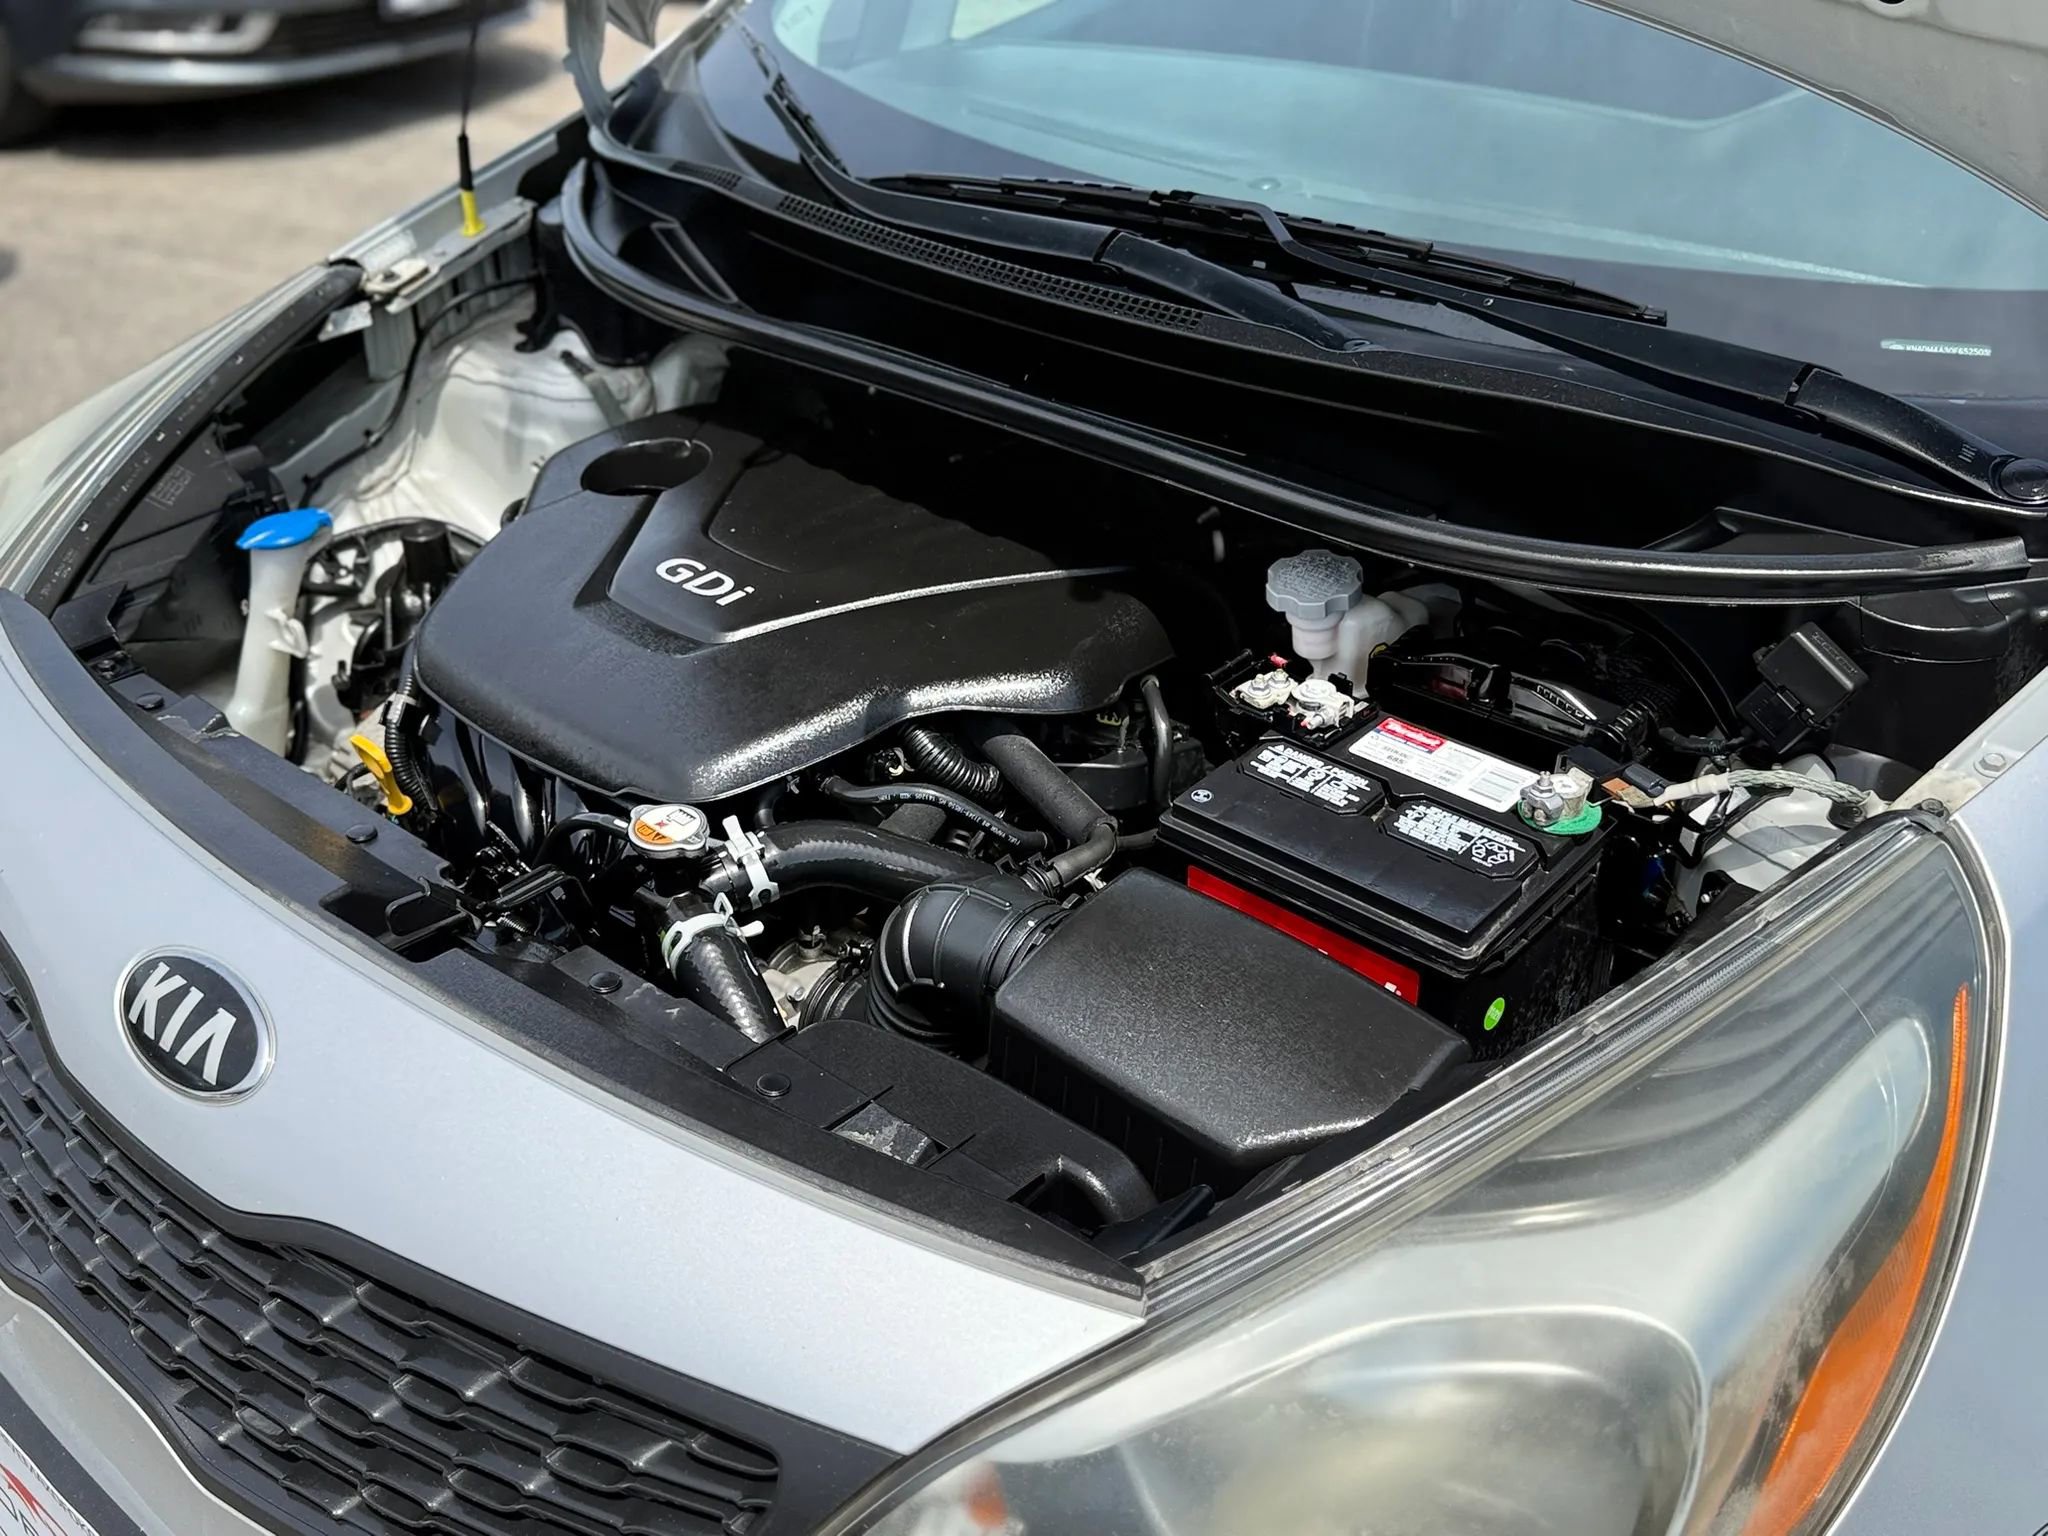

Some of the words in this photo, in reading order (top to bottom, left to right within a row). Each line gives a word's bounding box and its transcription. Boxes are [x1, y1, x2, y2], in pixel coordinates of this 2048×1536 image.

[655, 557, 756, 607] GDi
[1283, 747, 1325, 768] DANGER
[1330, 767, 1369, 786] POISON
[128, 961, 237, 1086] KIA
